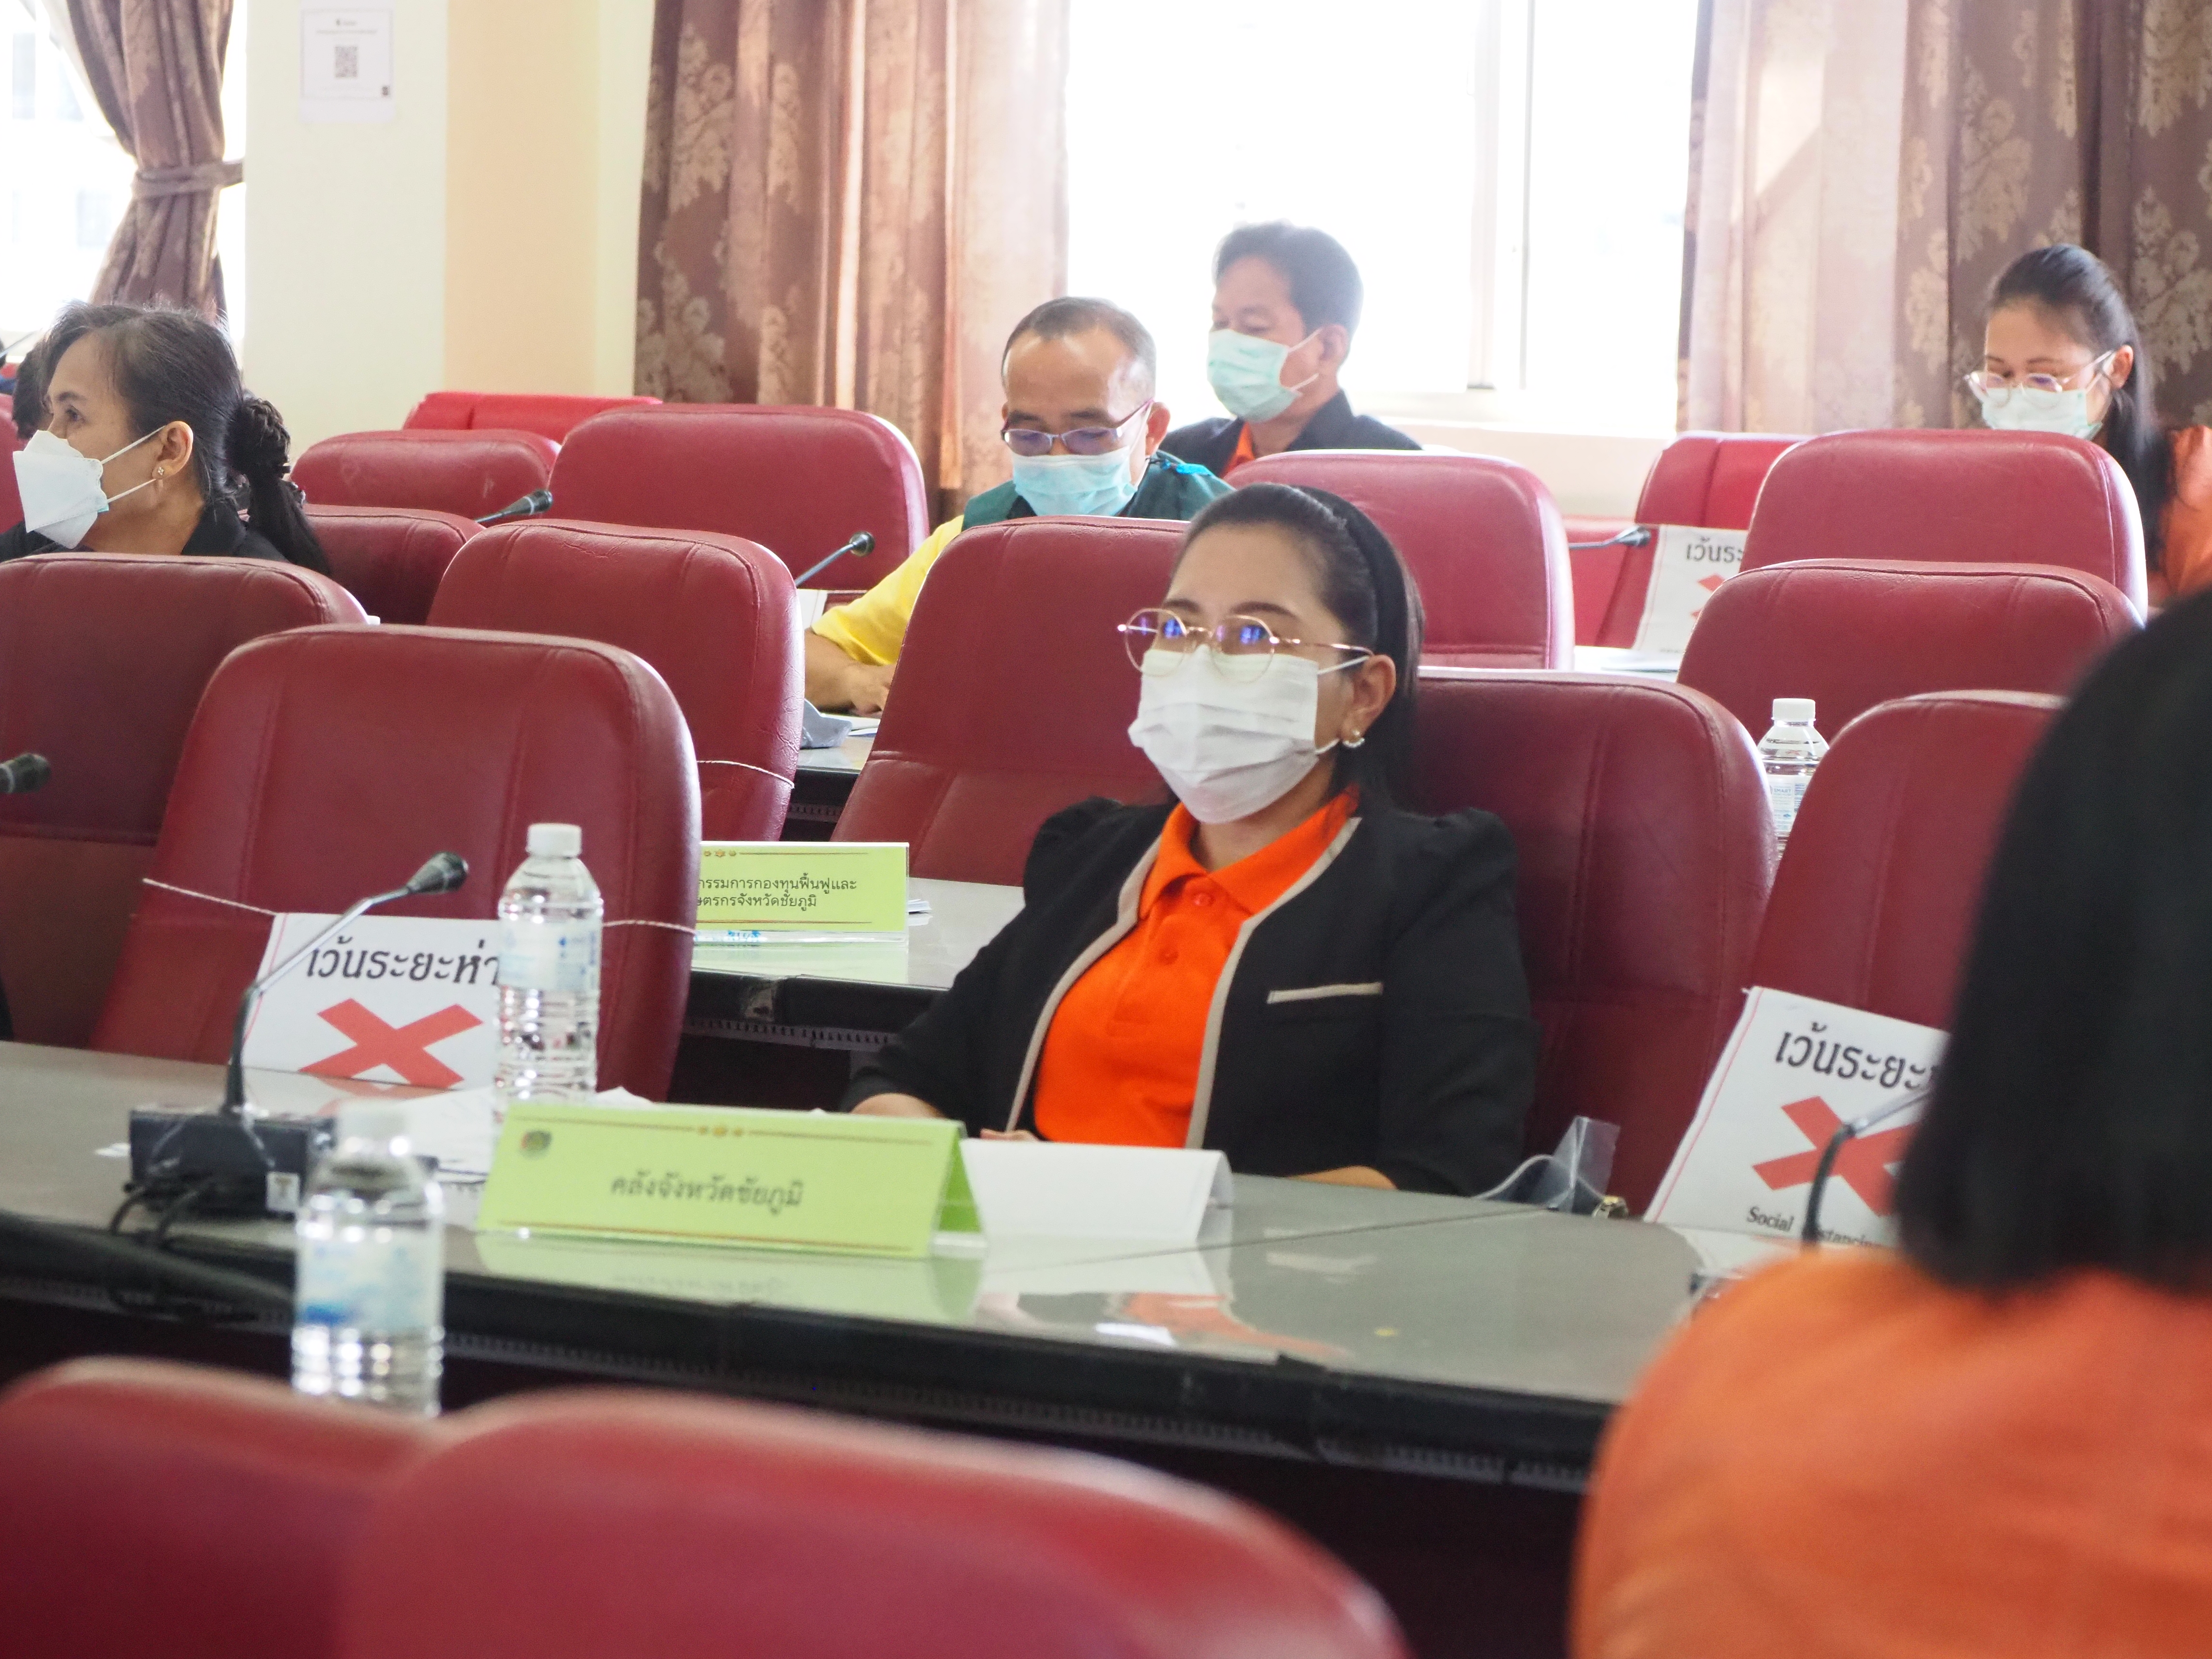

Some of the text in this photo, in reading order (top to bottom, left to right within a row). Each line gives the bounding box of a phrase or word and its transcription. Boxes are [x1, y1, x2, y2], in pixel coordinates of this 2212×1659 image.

[1775, 1022, 1937, 1089] เว้นระยะ
[1746, 1205, 1795, 1232] Social
